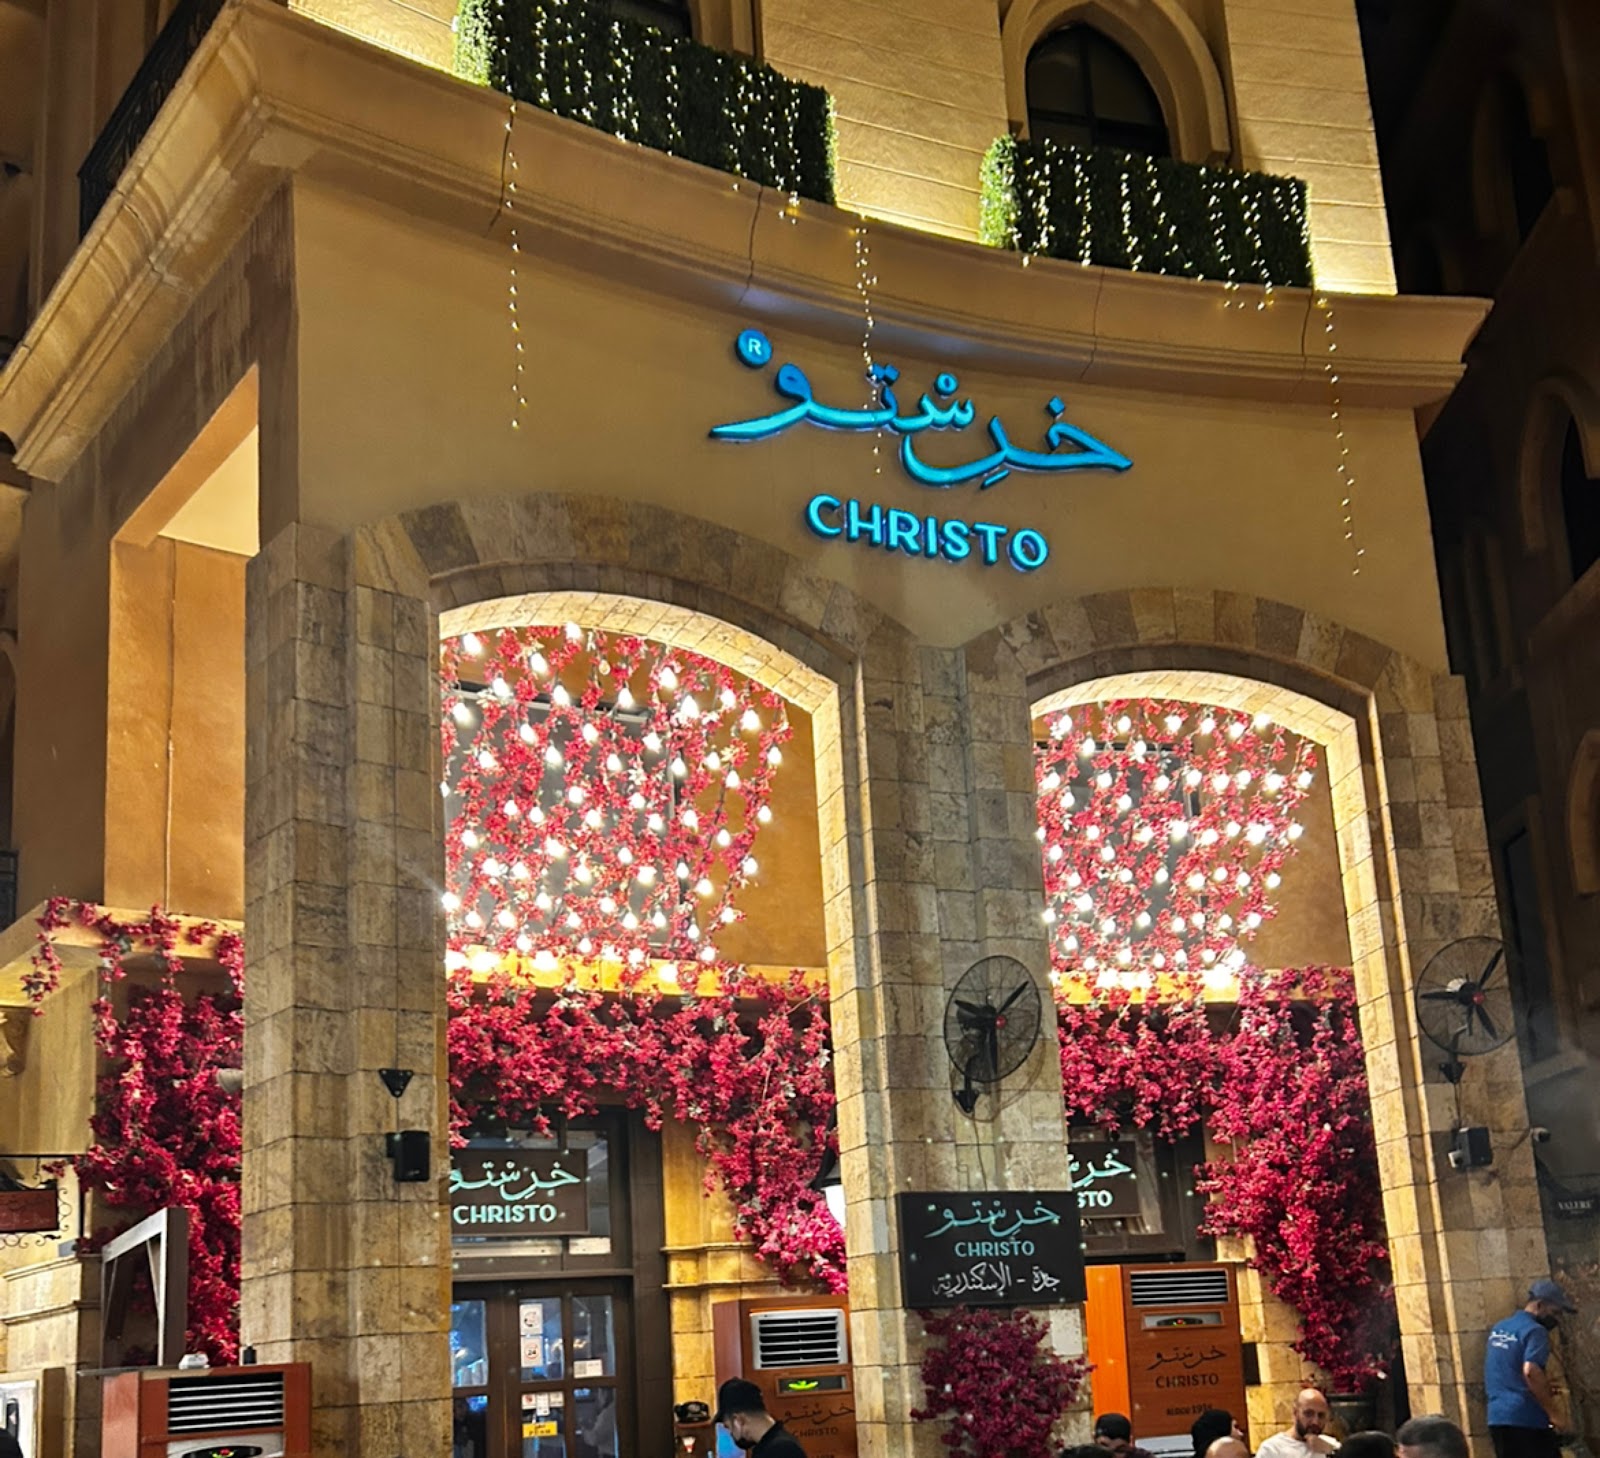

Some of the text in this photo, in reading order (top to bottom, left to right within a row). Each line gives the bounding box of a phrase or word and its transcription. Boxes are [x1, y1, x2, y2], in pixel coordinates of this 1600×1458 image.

[806, 493, 1049, 572] CHRISTO
[453, 1204, 557, 1225] CHRISTO
[954, 1241, 1035, 1257] CHRISTO
[1155, 1373, 1219, 1389] CHRISTO
